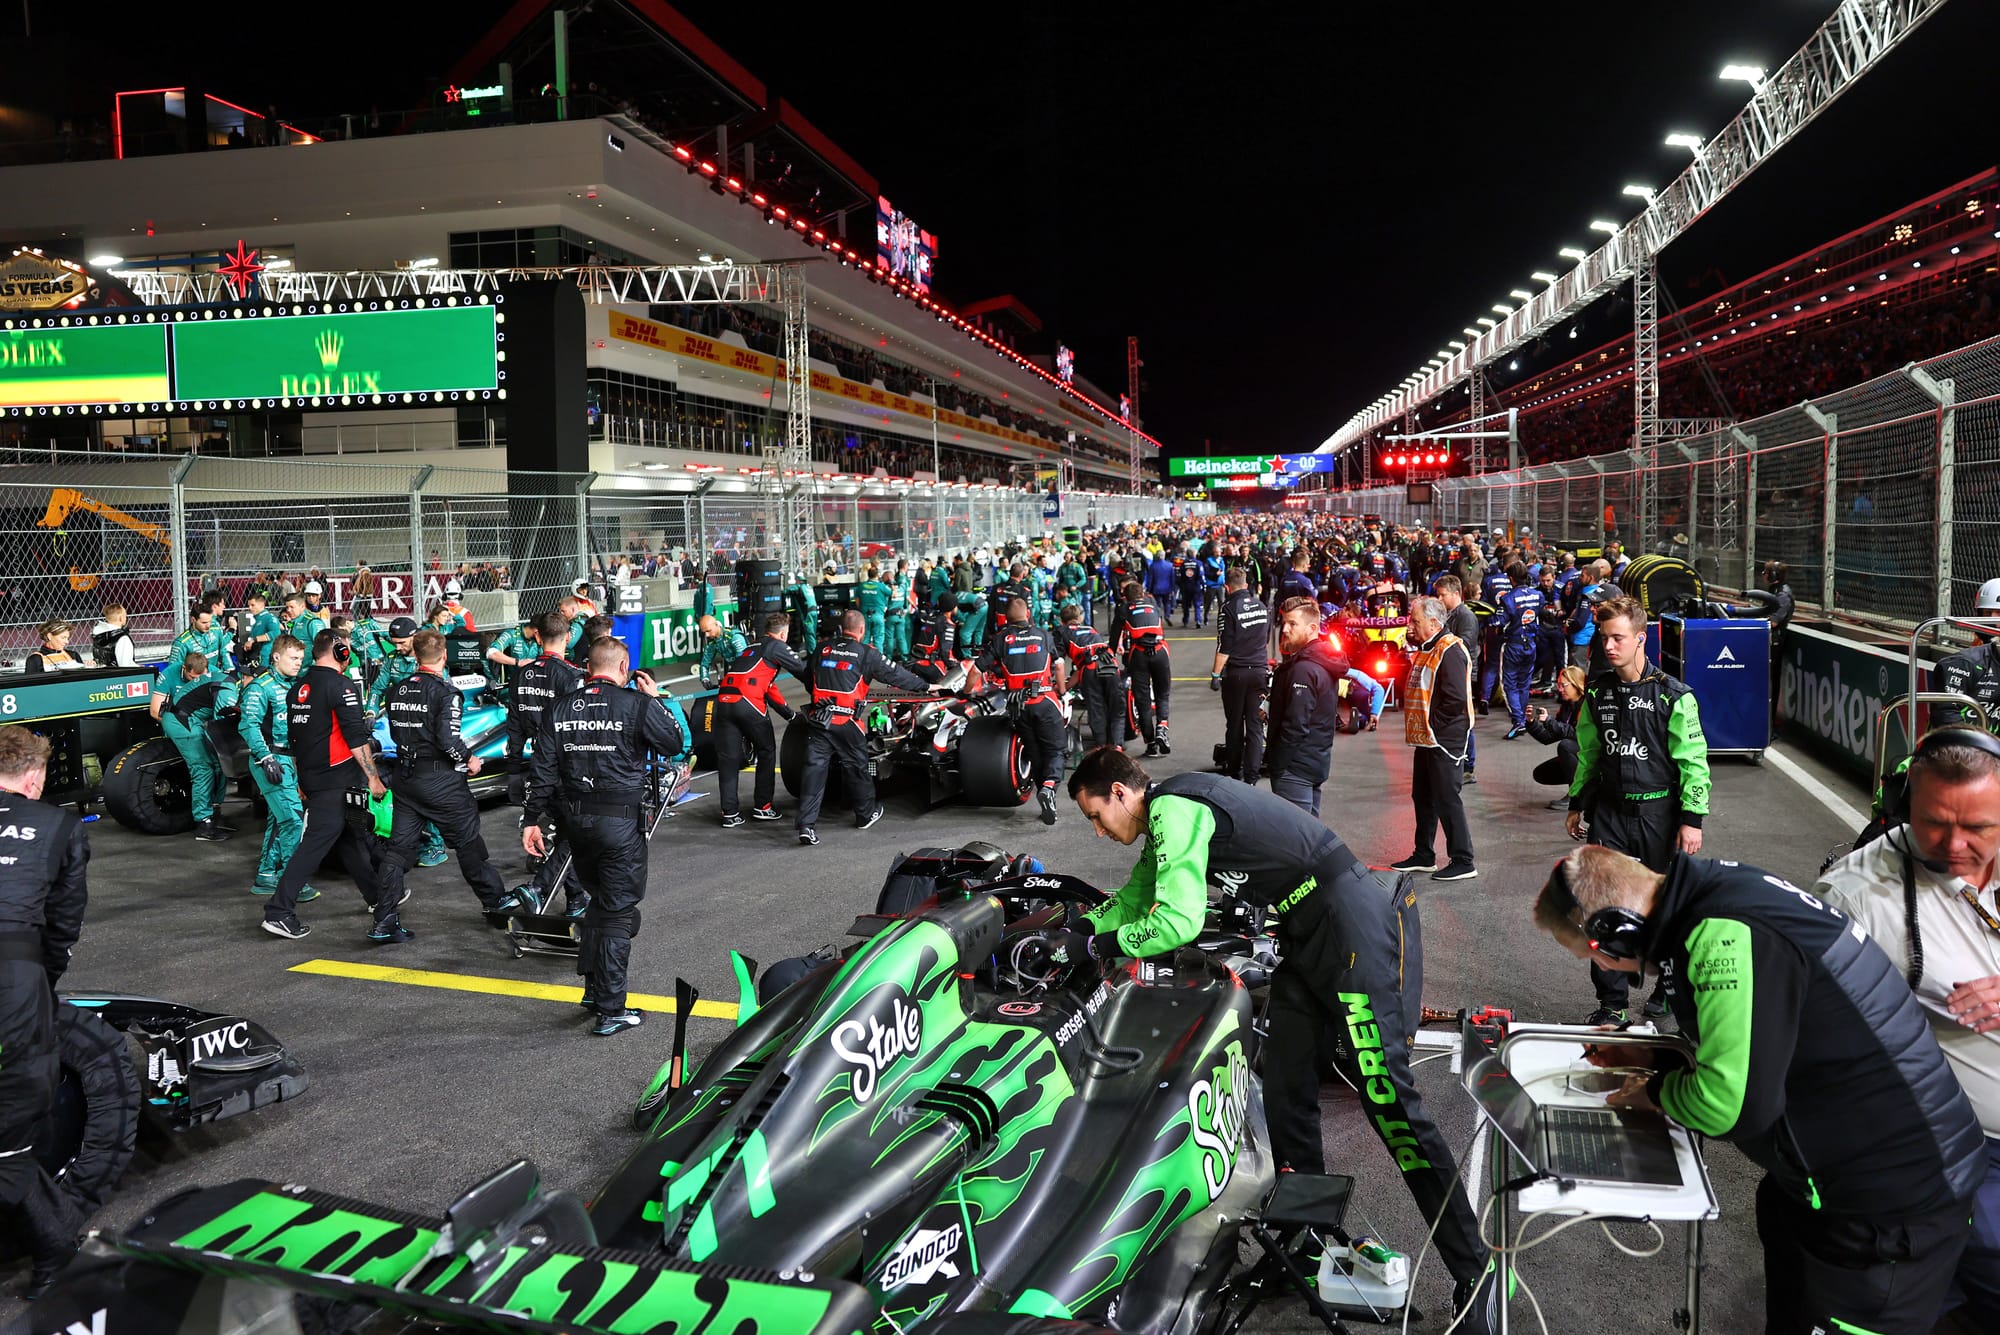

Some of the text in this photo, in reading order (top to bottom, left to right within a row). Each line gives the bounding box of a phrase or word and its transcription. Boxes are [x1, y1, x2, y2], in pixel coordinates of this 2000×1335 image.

[9, 273, 48, 281] FORMULA
[20, 281, 74, 295] VEGAS
[623, 319, 661, 343] DHL
[685, 337, 715, 359] DHL
[734, 351, 760, 371] DHL
[1184, 459, 1262, 475] Heineken
[620, 602, 642, 612] ALB
[1950, 675, 1962, 683] FIX
[88, 691, 125, 703] STROLL
[555, 720, 624, 732] PETRONAS
[1604, 729, 1649, 761] Stake
[1625, 789, 1670, 801] PIT CREW
[1024, 876, 1062, 889] Stake
[1288, 875, 1318, 905] CREW
[1095, 896, 1119, 920] Stake
[1126, 926, 1160, 950] Stake
[191, 1020, 249, 1063] IWC
[831, 998, 920, 1102] Stake
[1337, 991, 1431, 1172] PIT CREW
[1188, 1051, 1249, 1201] Stake
[886, 1227, 958, 1287] SUNOCO
